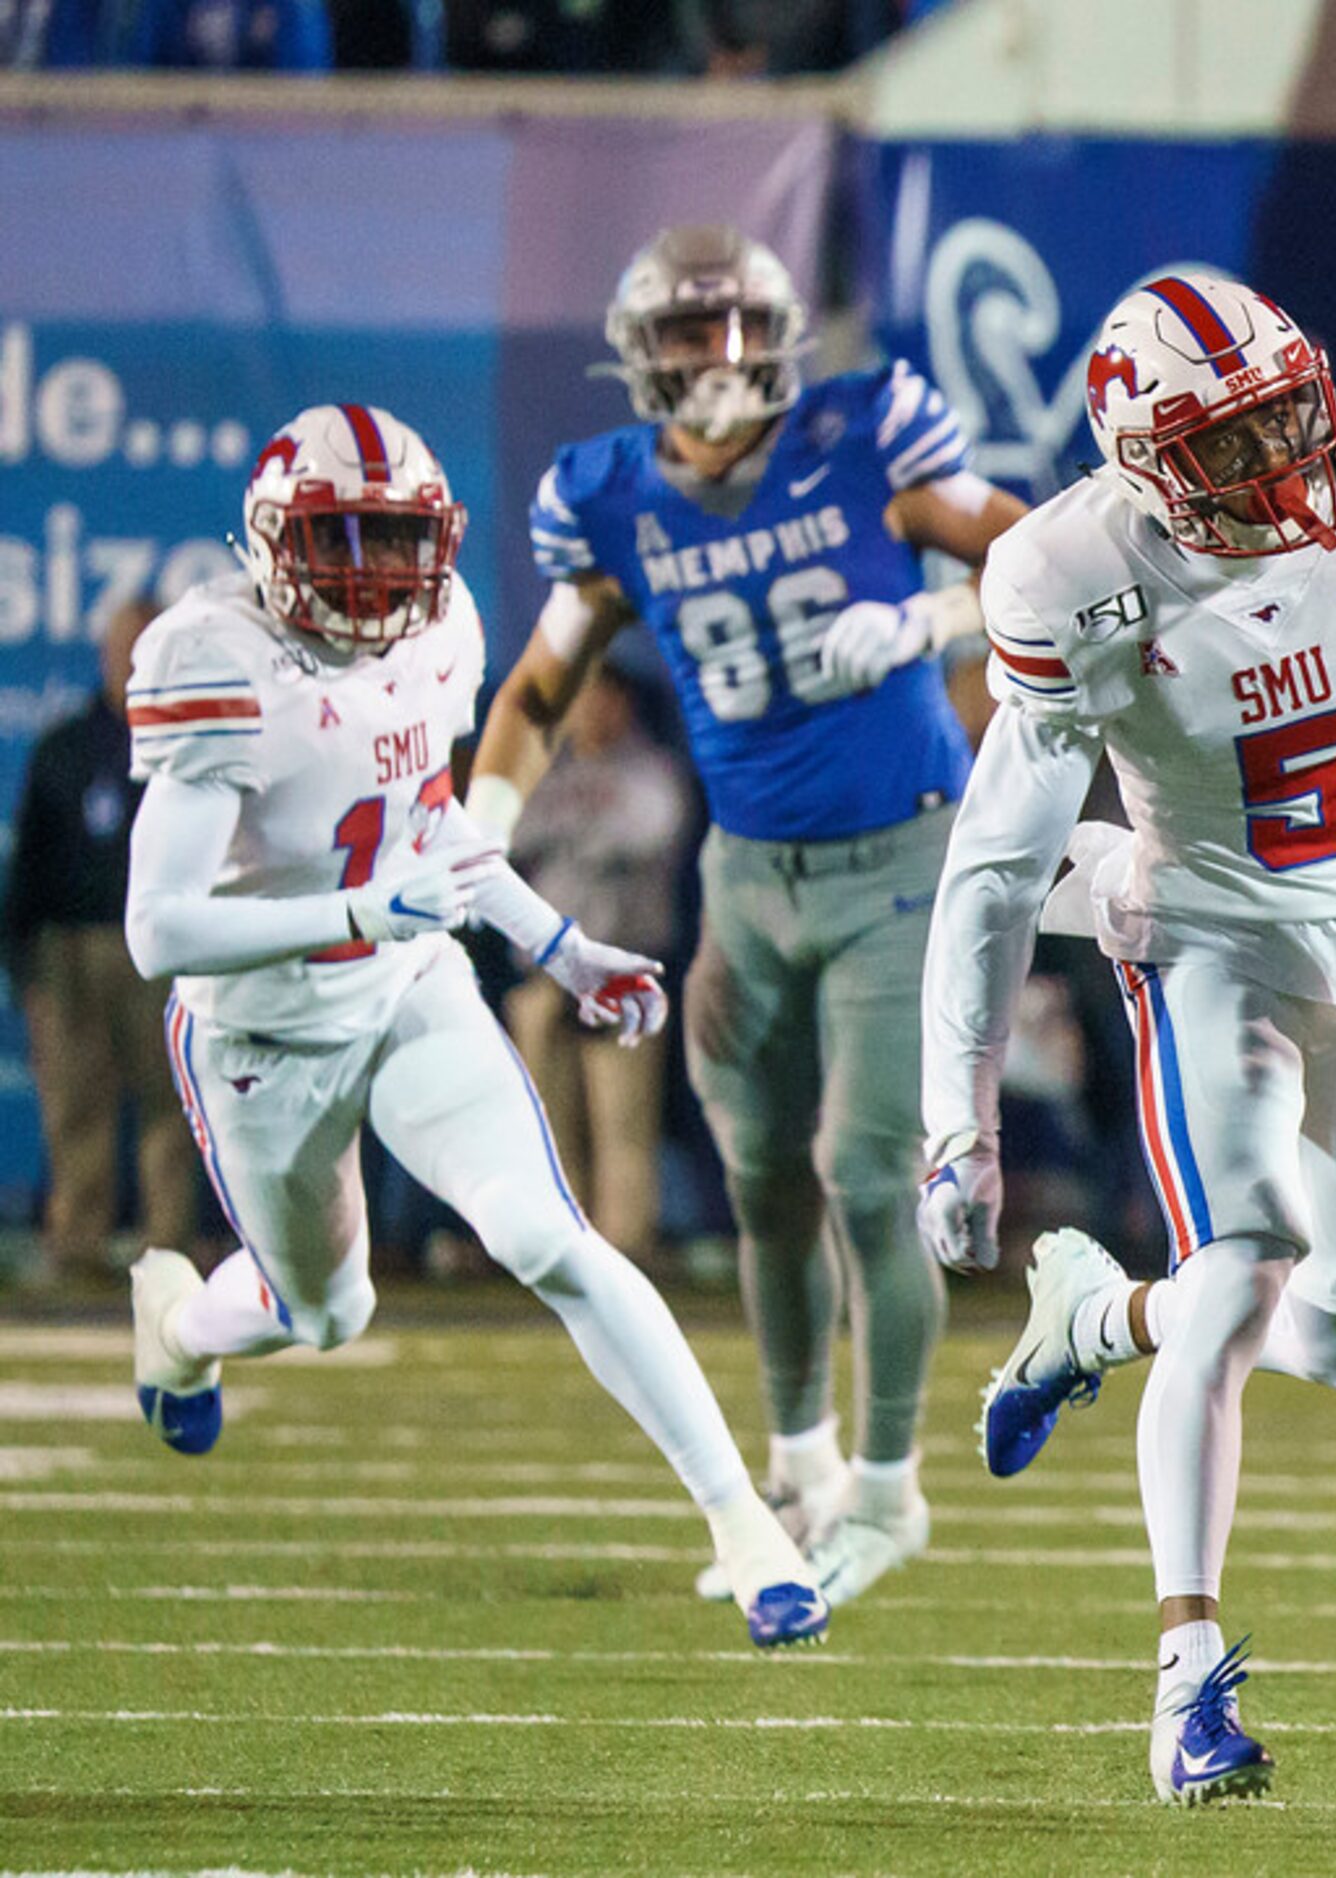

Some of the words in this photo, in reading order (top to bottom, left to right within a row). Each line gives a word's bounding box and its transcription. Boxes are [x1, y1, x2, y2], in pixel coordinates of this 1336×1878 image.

[1225, 366, 1263, 394] SMU
[644, 505, 850, 596] MEMPHIS
[677, 565, 848, 722] 86
[1075, 583, 1148, 645] 150
[1231, 645, 1331, 725] SMU
[374, 720, 429, 786] SMU
